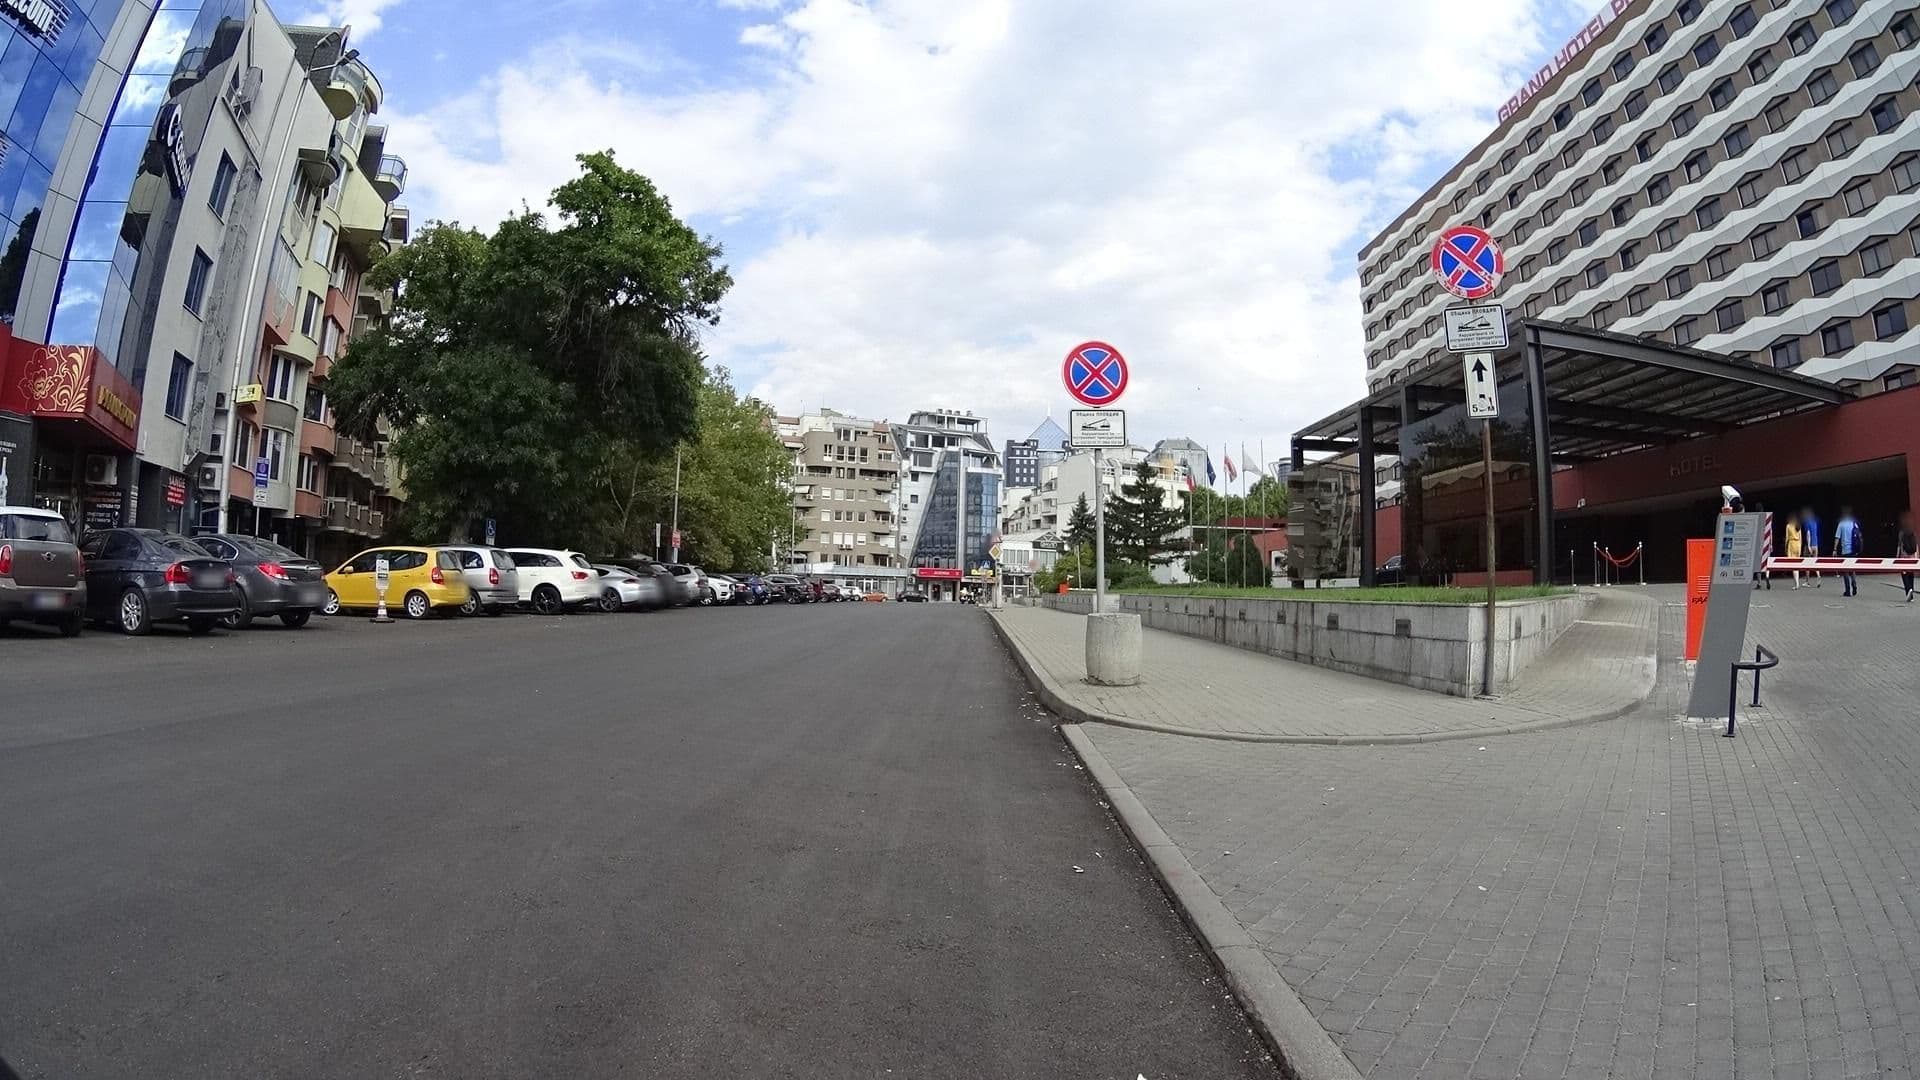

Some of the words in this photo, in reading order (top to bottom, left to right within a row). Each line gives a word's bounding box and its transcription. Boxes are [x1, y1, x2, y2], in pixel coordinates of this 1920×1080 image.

[1497, 64, 1553, 124] GRAND
[1555, 14, 1607, 73] HOTEL
[1669, 456, 1721, 478] HOTEL
